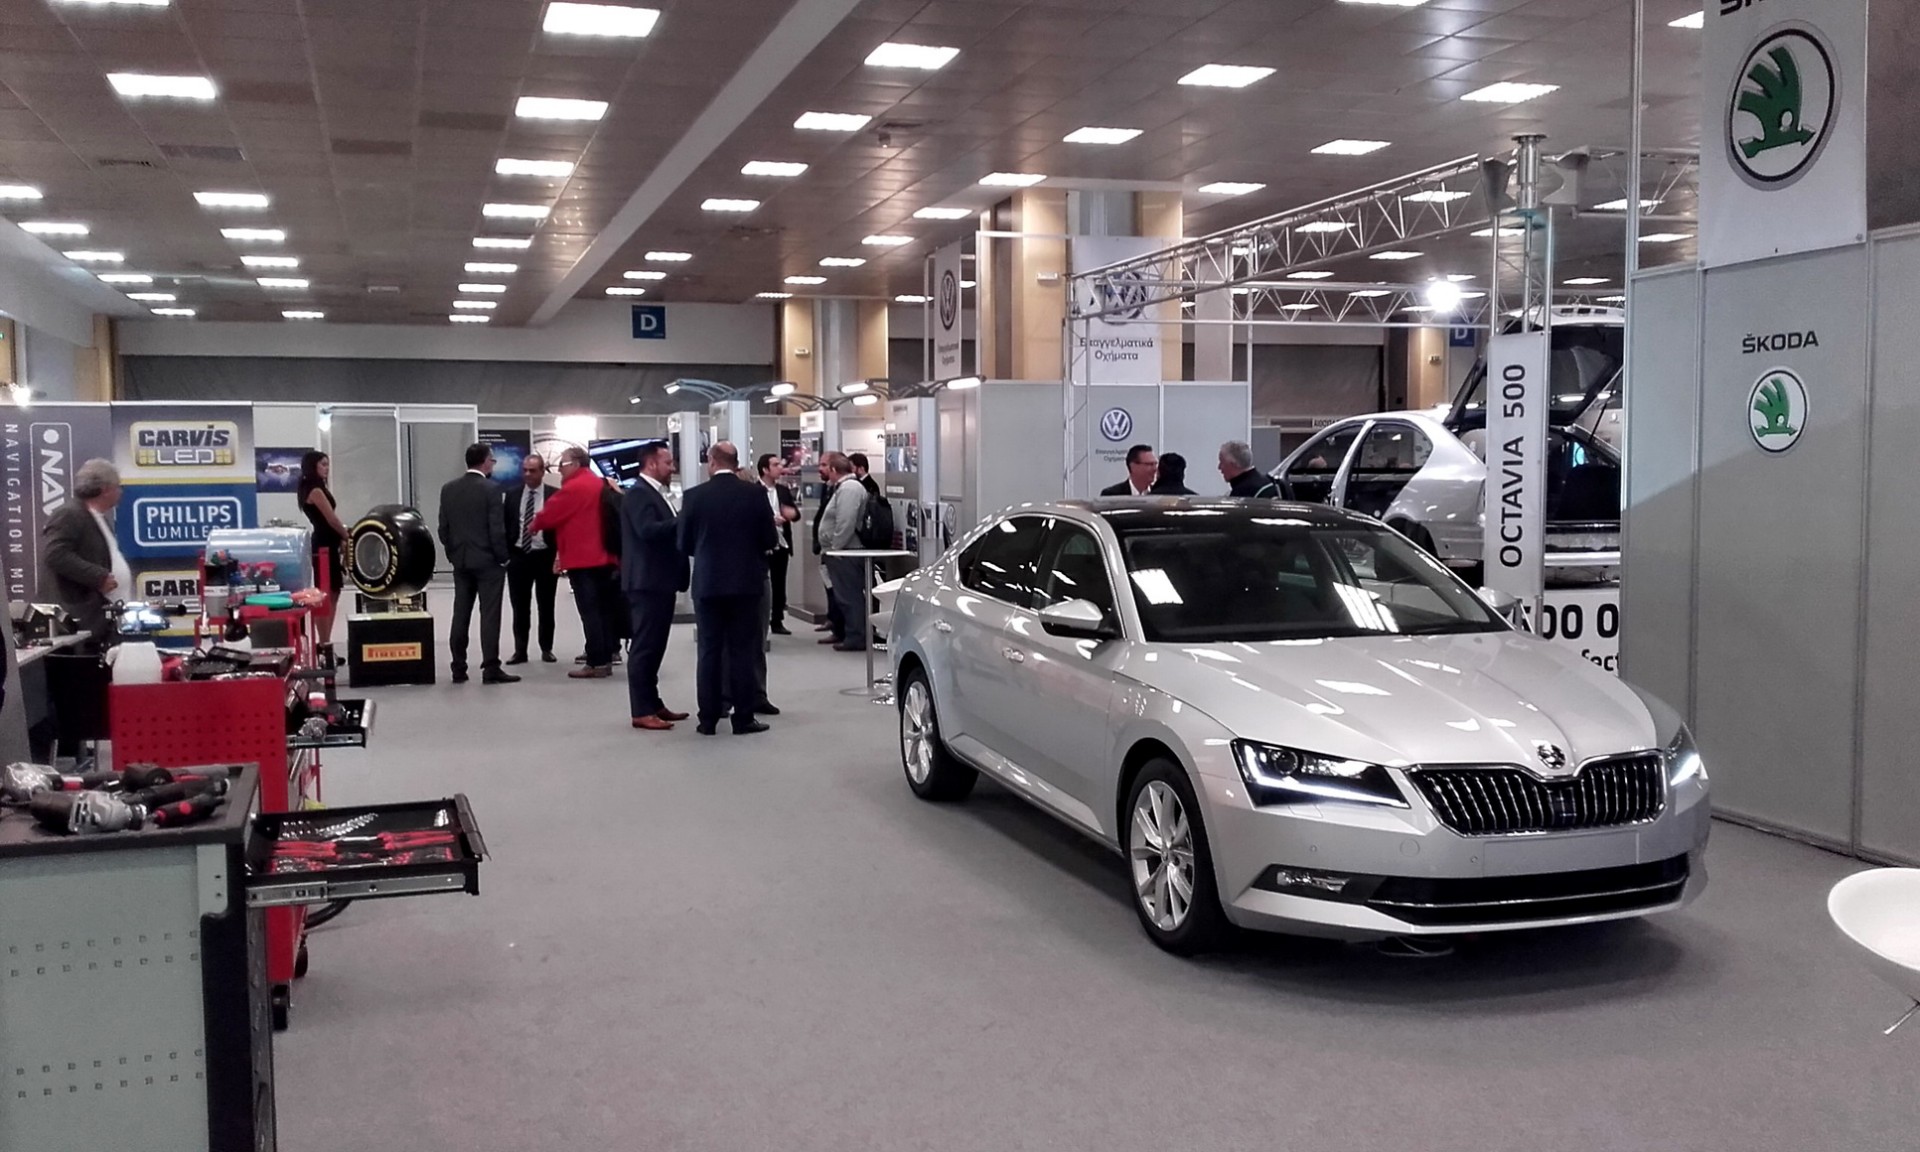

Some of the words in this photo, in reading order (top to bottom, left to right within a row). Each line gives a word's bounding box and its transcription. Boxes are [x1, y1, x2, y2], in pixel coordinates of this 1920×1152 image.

[640, 313, 657, 331] D
[1742, 331, 1819, 354] ŠKODA
[1095, 350, 1138, 362] Οχήματα
[1502, 364, 1526, 418] 500
[157, 448, 215, 464] LED
[5, 423, 23, 553] NAVIGATION
[1500, 436, 1525, 568] OCTAVIA
[146, 505, 232, 524] PHILIPS
[147, 525, 231, 540] LUMILE
[10, 568, 25, 603] MU
[145, 578, 201, 597] CAR
